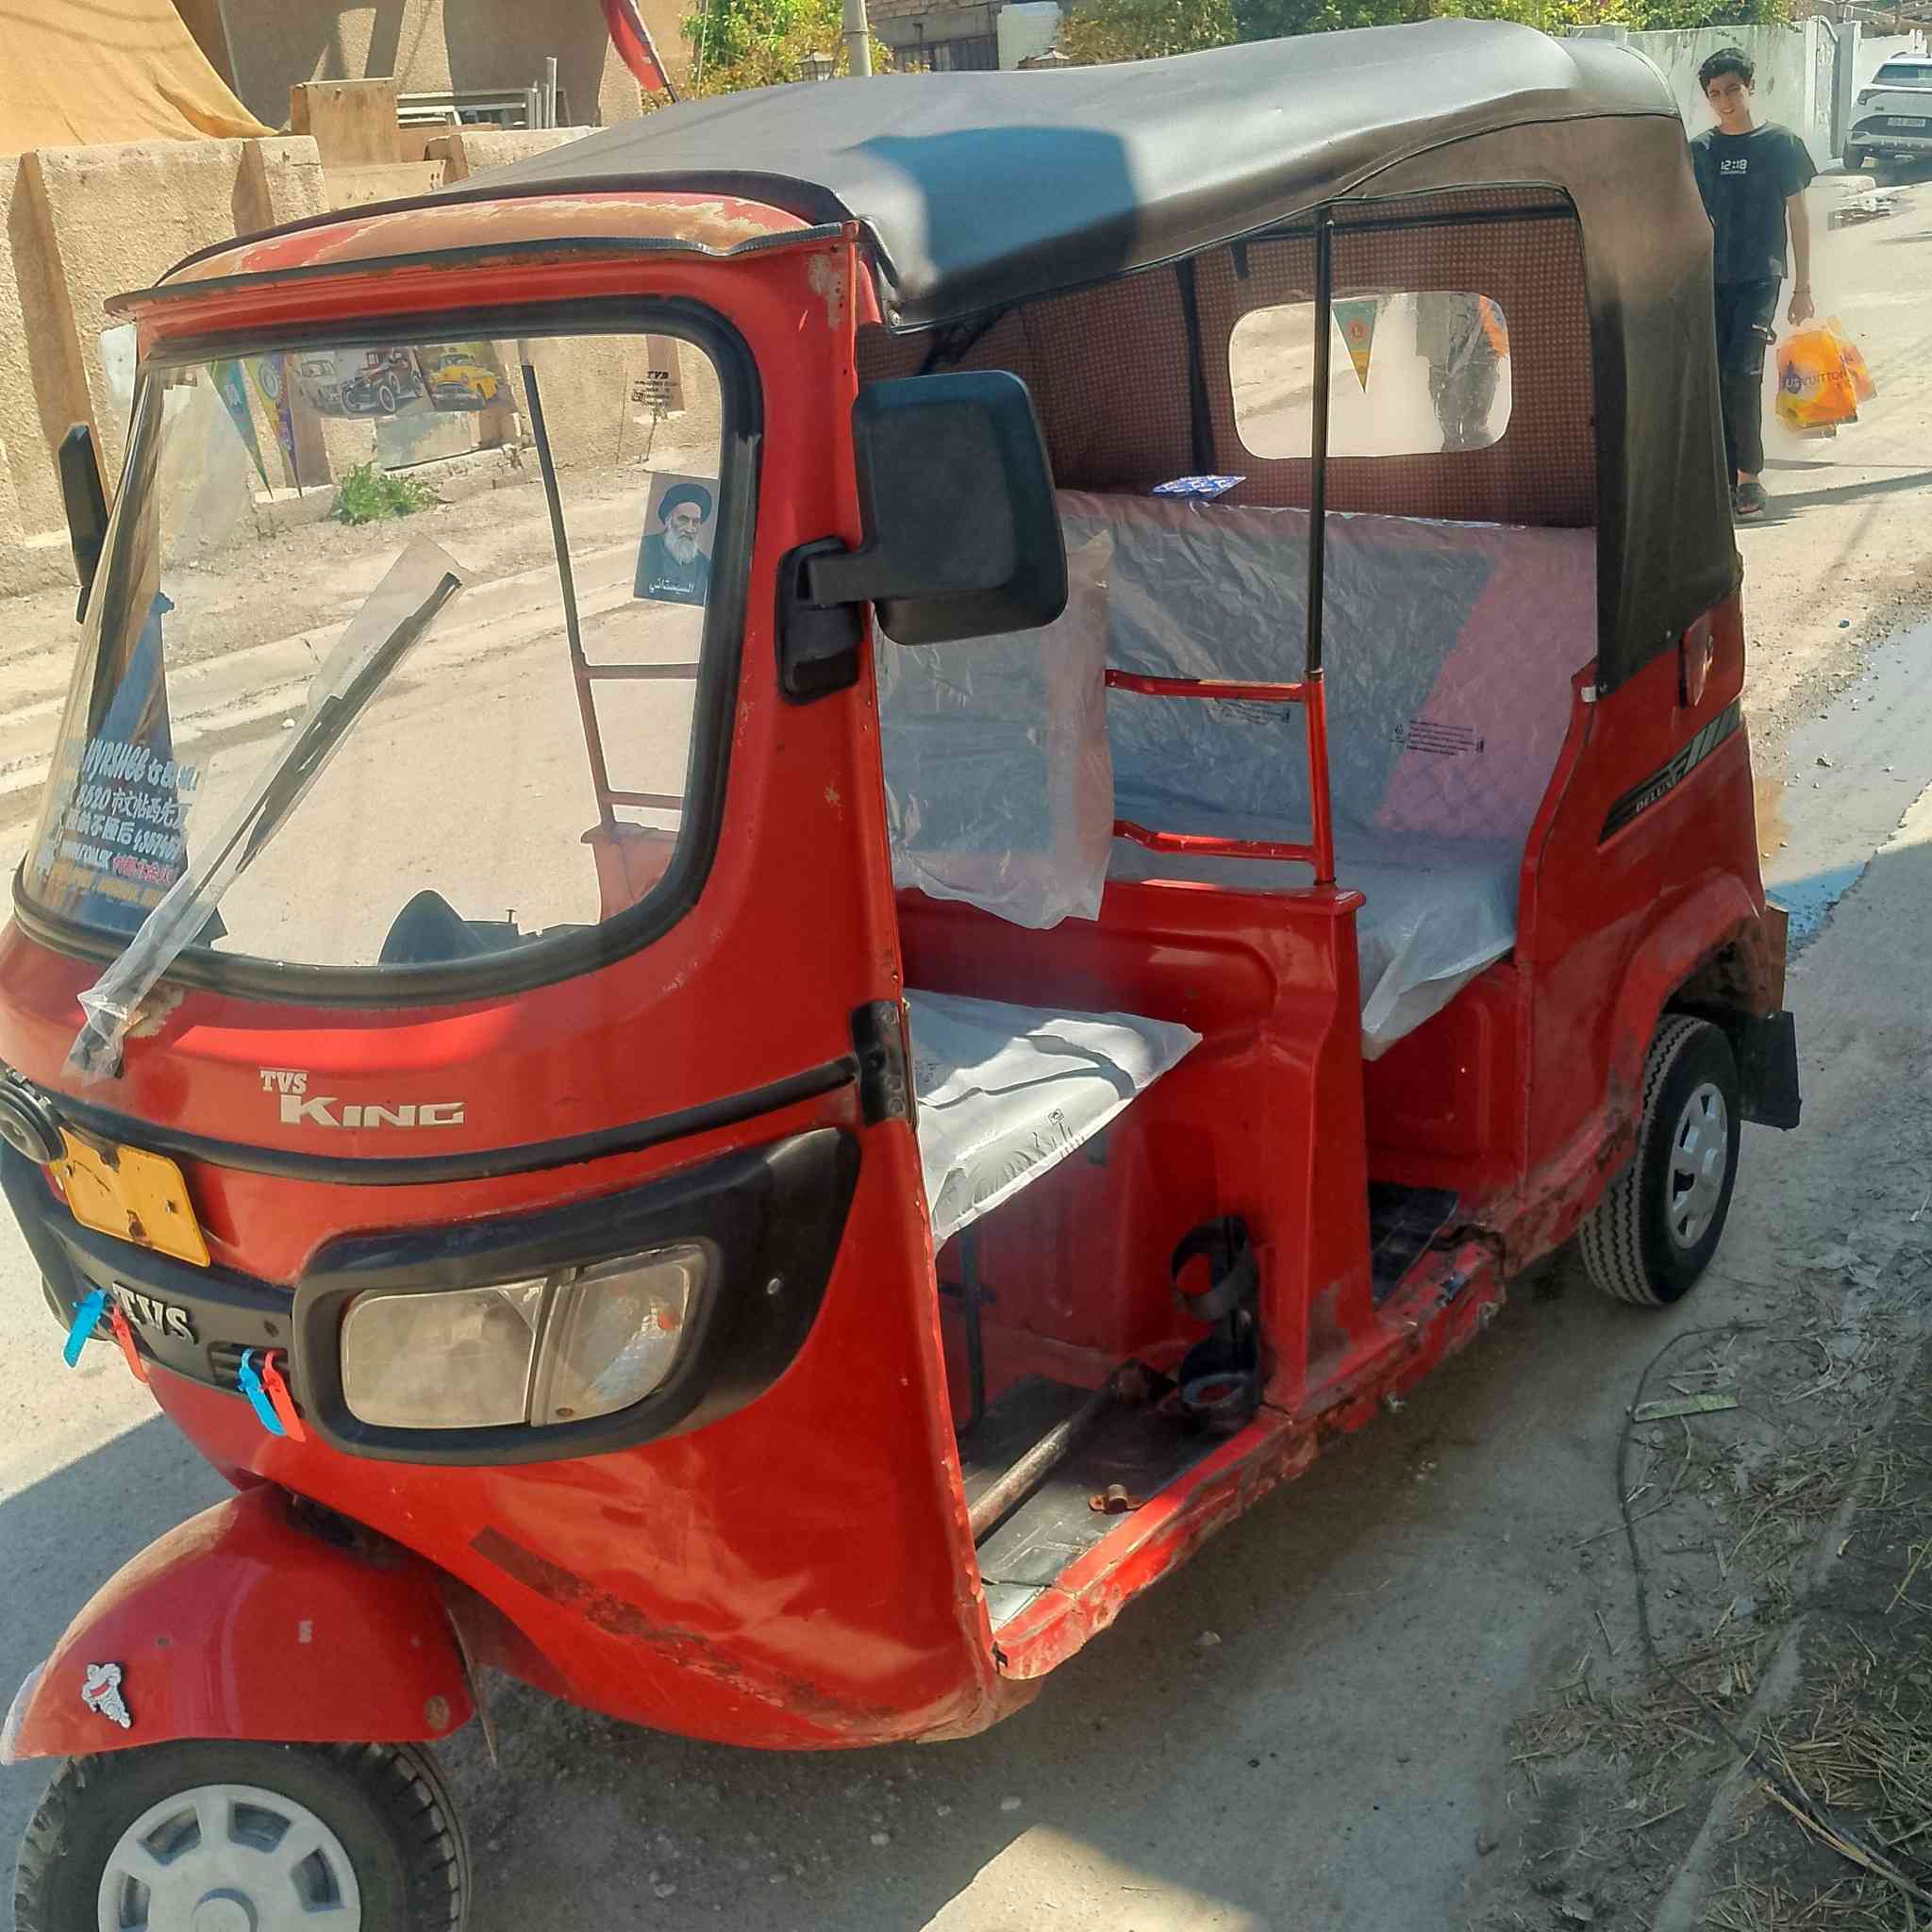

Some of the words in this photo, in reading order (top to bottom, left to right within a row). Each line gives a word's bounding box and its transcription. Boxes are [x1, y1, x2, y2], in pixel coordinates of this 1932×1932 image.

[648, 576, 695, 594] السيستاني
[260, 1070, 308, 1094] TVS
[279, 1093, 465, 1127] KING
[112, 1282, 195, 1343] TVS
